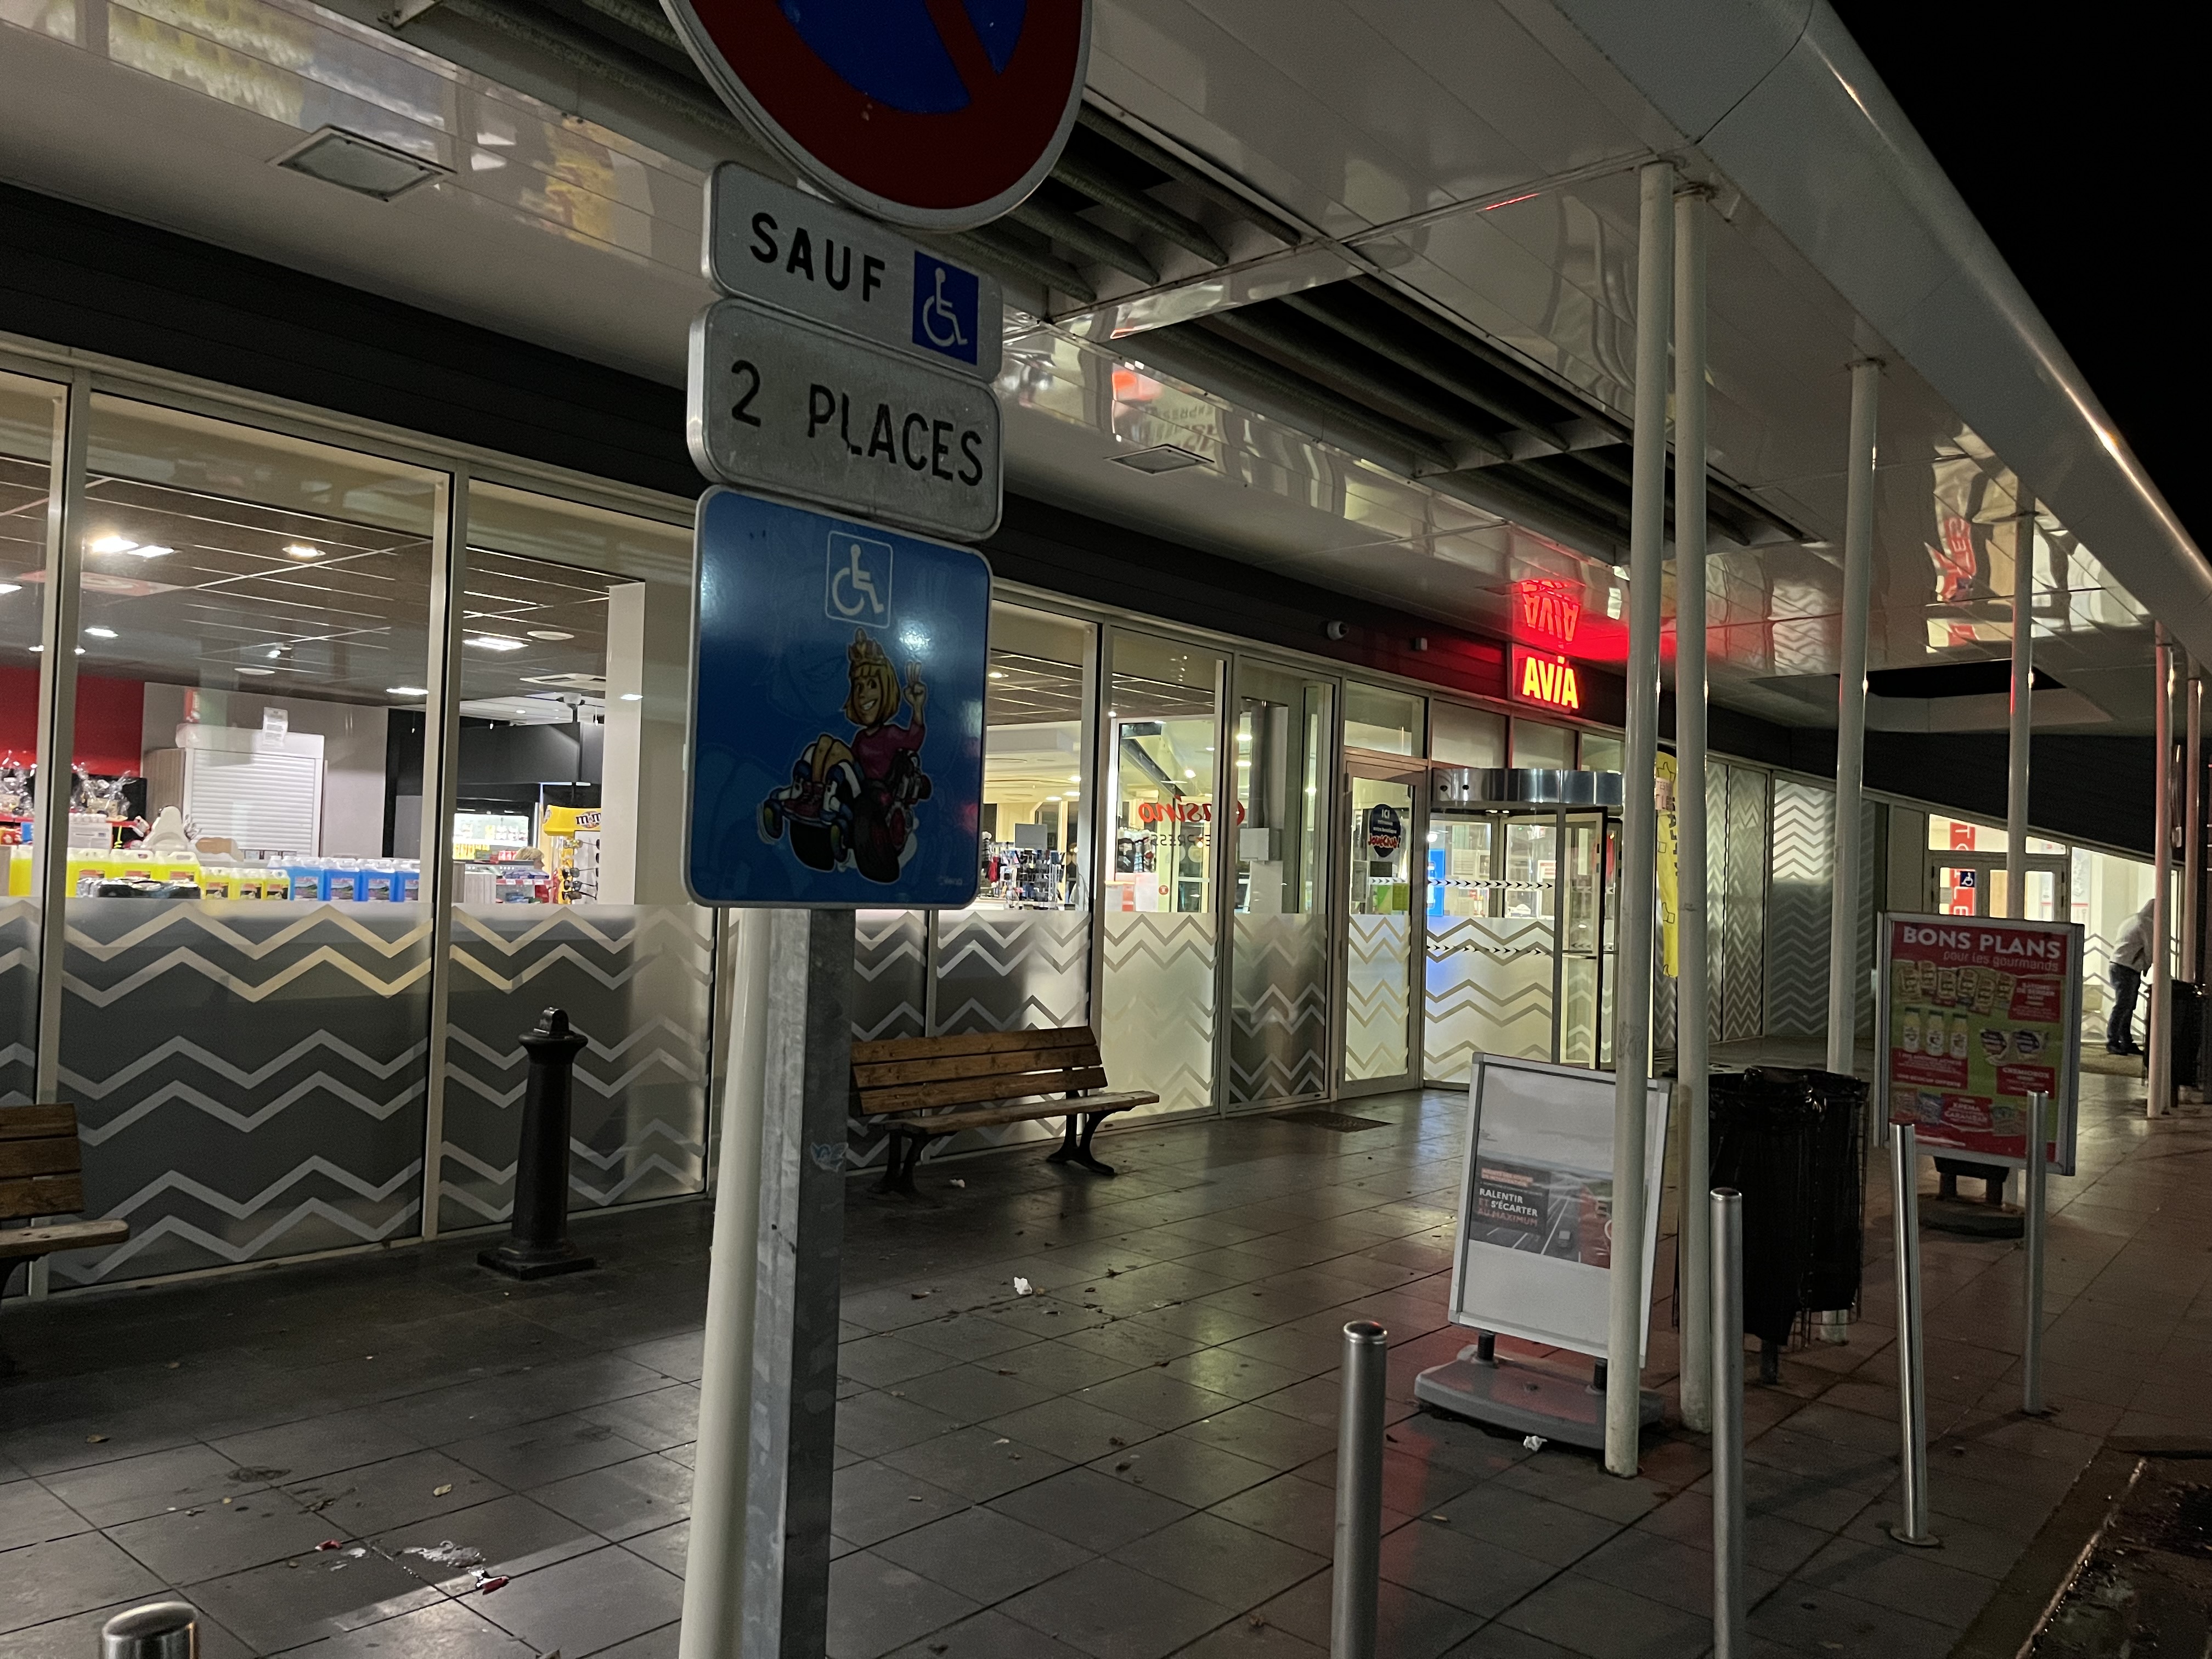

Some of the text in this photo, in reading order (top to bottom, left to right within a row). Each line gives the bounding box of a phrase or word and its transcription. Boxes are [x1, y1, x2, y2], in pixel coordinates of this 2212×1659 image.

[749, 212, 885, 302] SAUF
[731, 360, 984, 487] 2 PLACES
[1381, 809, 1390, 819] ICI
[1903, 926, 2061, 960] BONS PLANS
[1943, 951, 2059, 972] pour les gourmands
[1479, 1188, 1523, 1204] RALENTIR
[1477, 1208, 1538, 1227] AU MAXIMUM
[1479, 1198, 1538, 1217] ET S'ÉCARTER
